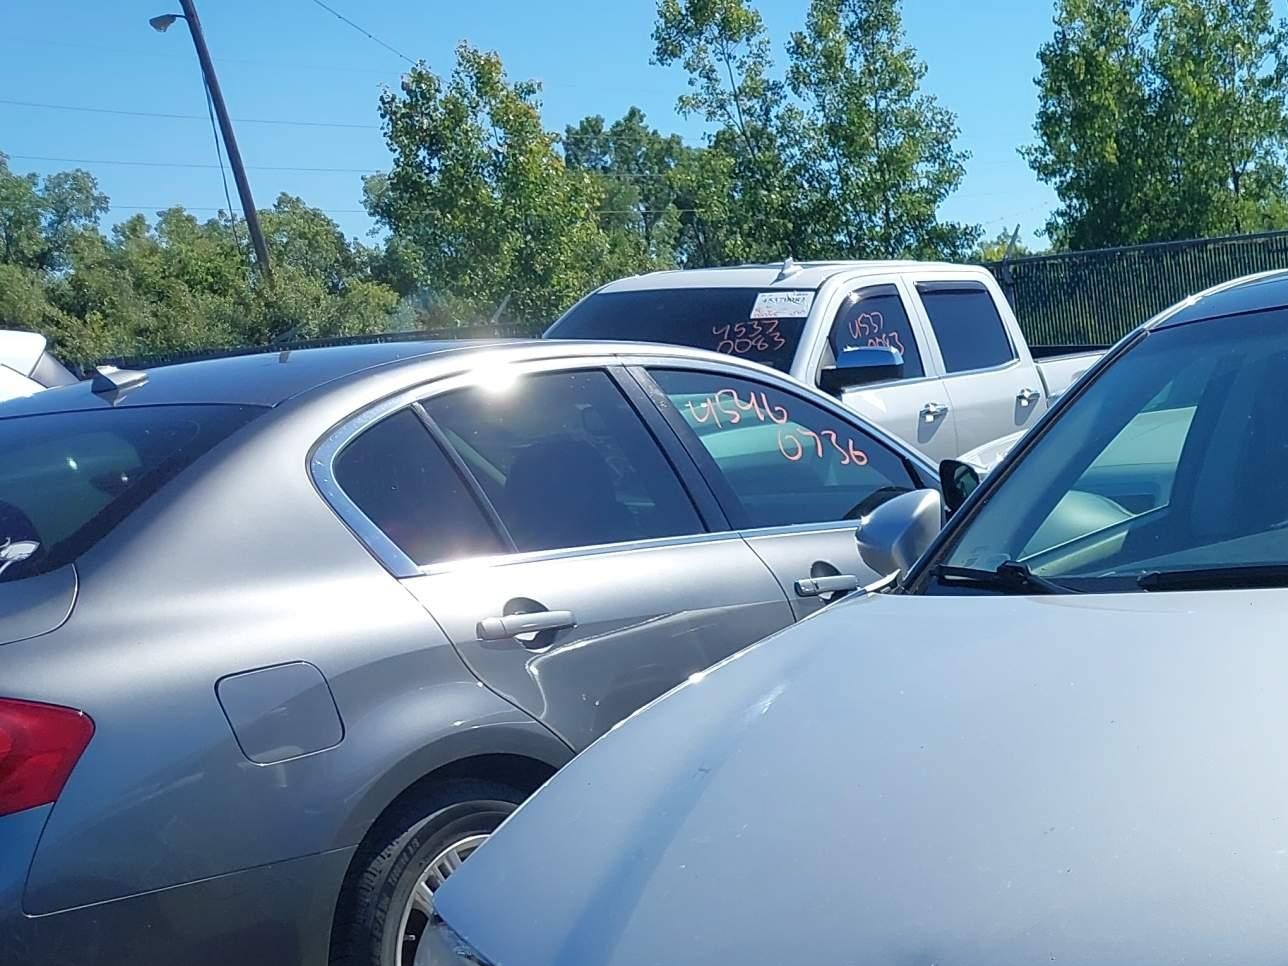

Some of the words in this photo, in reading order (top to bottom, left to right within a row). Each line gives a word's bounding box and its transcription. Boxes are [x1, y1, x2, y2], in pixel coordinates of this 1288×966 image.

[712, 319, 779, 340] 4537
[848, 311, 884, 340] 4537
[687, 388, 788, 430] 4546
[776, 427, 868, 466] 0736
